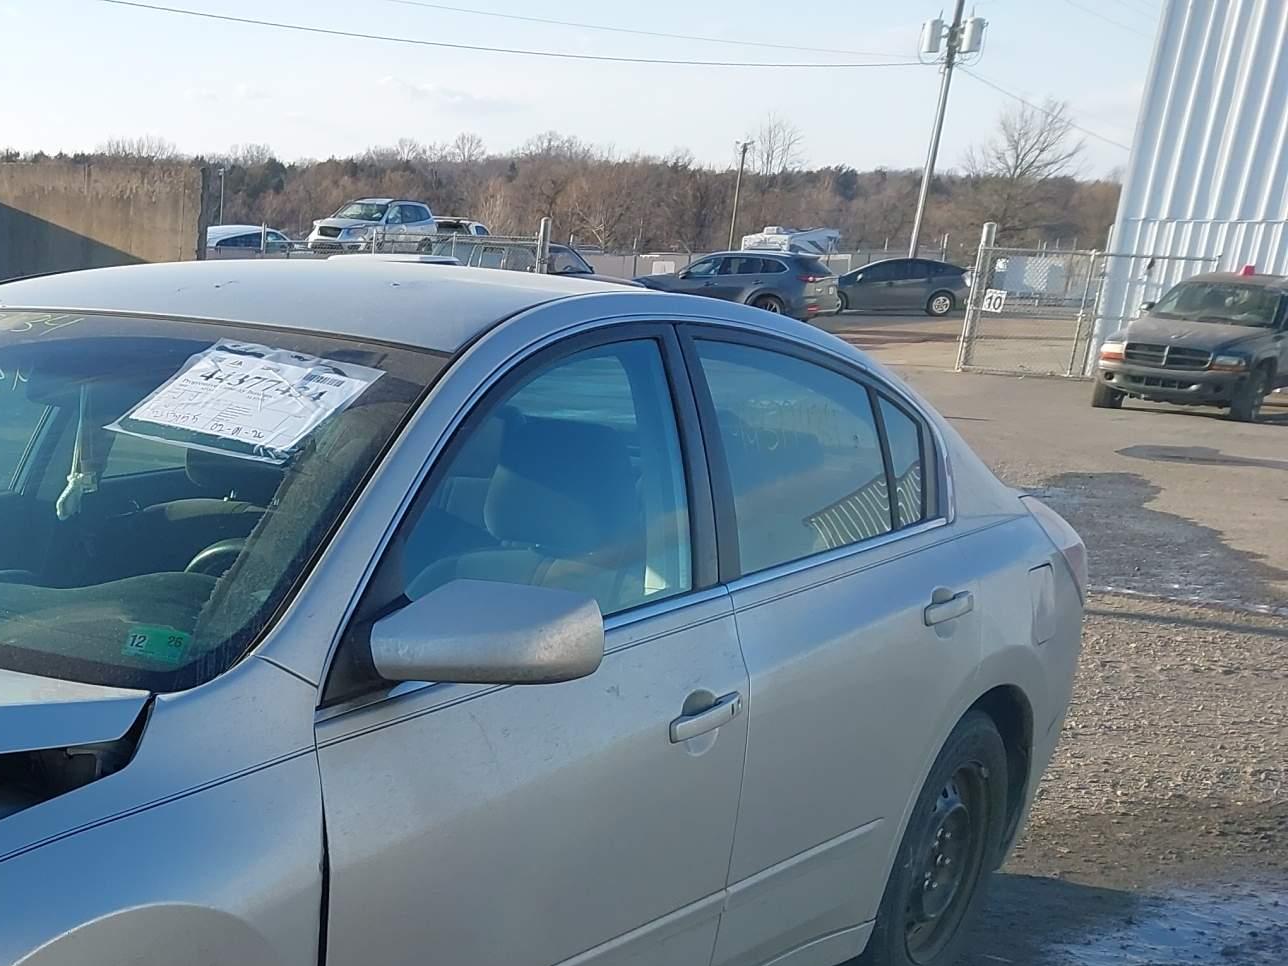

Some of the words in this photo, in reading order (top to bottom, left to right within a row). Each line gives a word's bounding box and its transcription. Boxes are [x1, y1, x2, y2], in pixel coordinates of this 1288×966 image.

[985, 294, 1003, 311] 10
[130, 634, 147, 648] 12
[167, 635, 184, 648] 26
